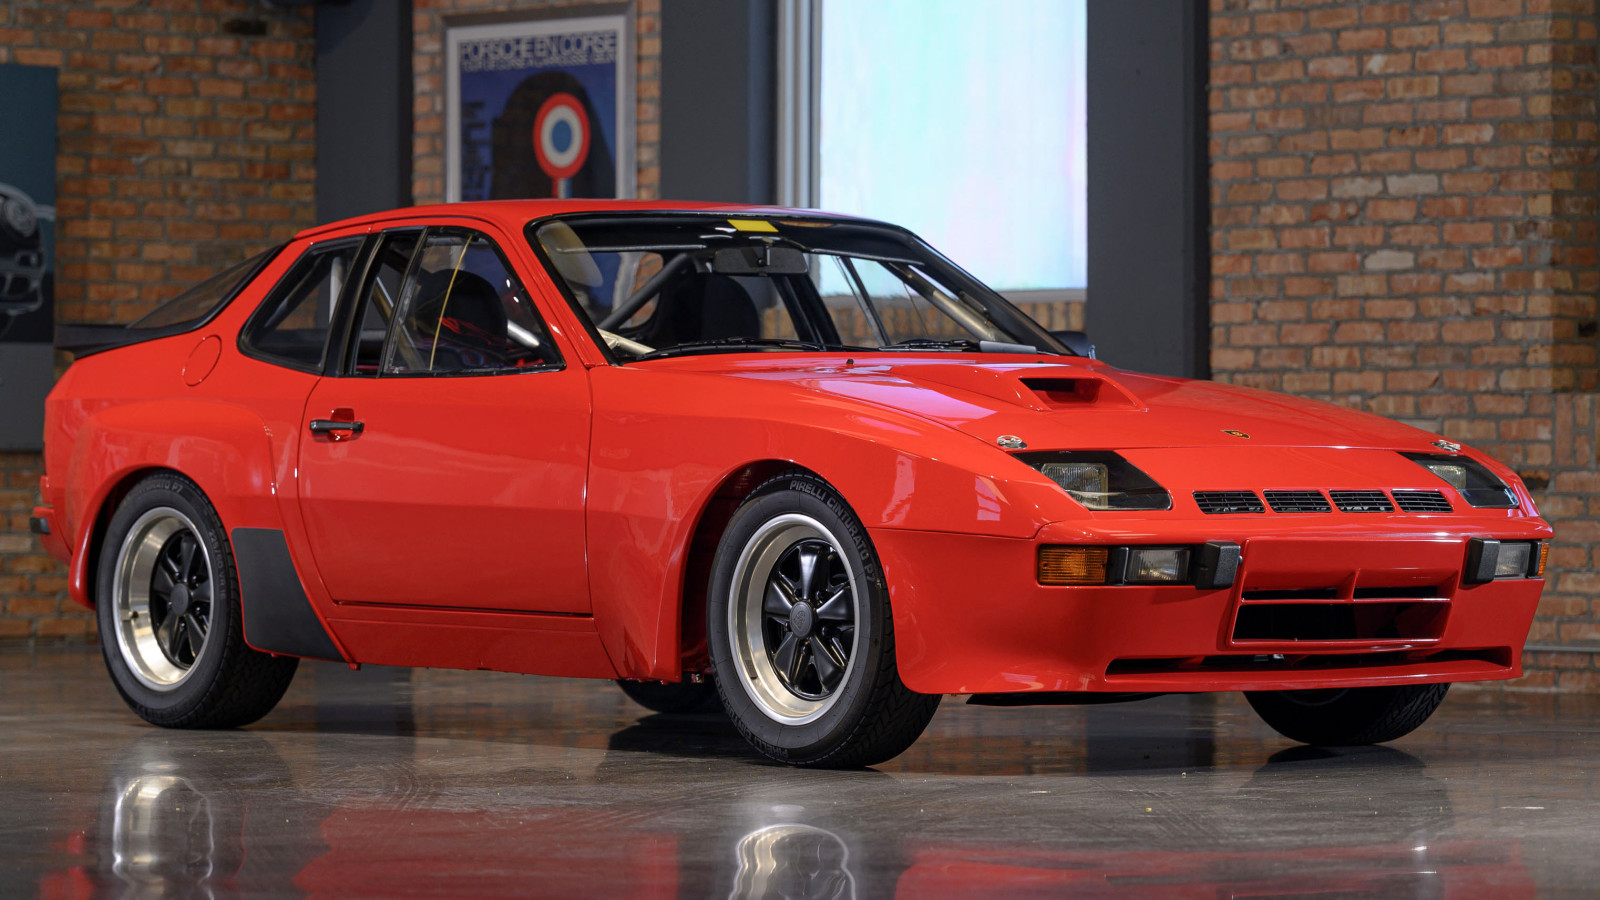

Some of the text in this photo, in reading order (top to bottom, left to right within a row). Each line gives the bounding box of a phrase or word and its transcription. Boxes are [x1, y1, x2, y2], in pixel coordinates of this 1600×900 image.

[460, 30, 616, 61] PORSCHE EN CORSE
[171, 482, 183, 493] P7
[789, 480, 876, 582] PIRELLI CINTURATO P7
[754, 737, 789, 758] PIRELLI
